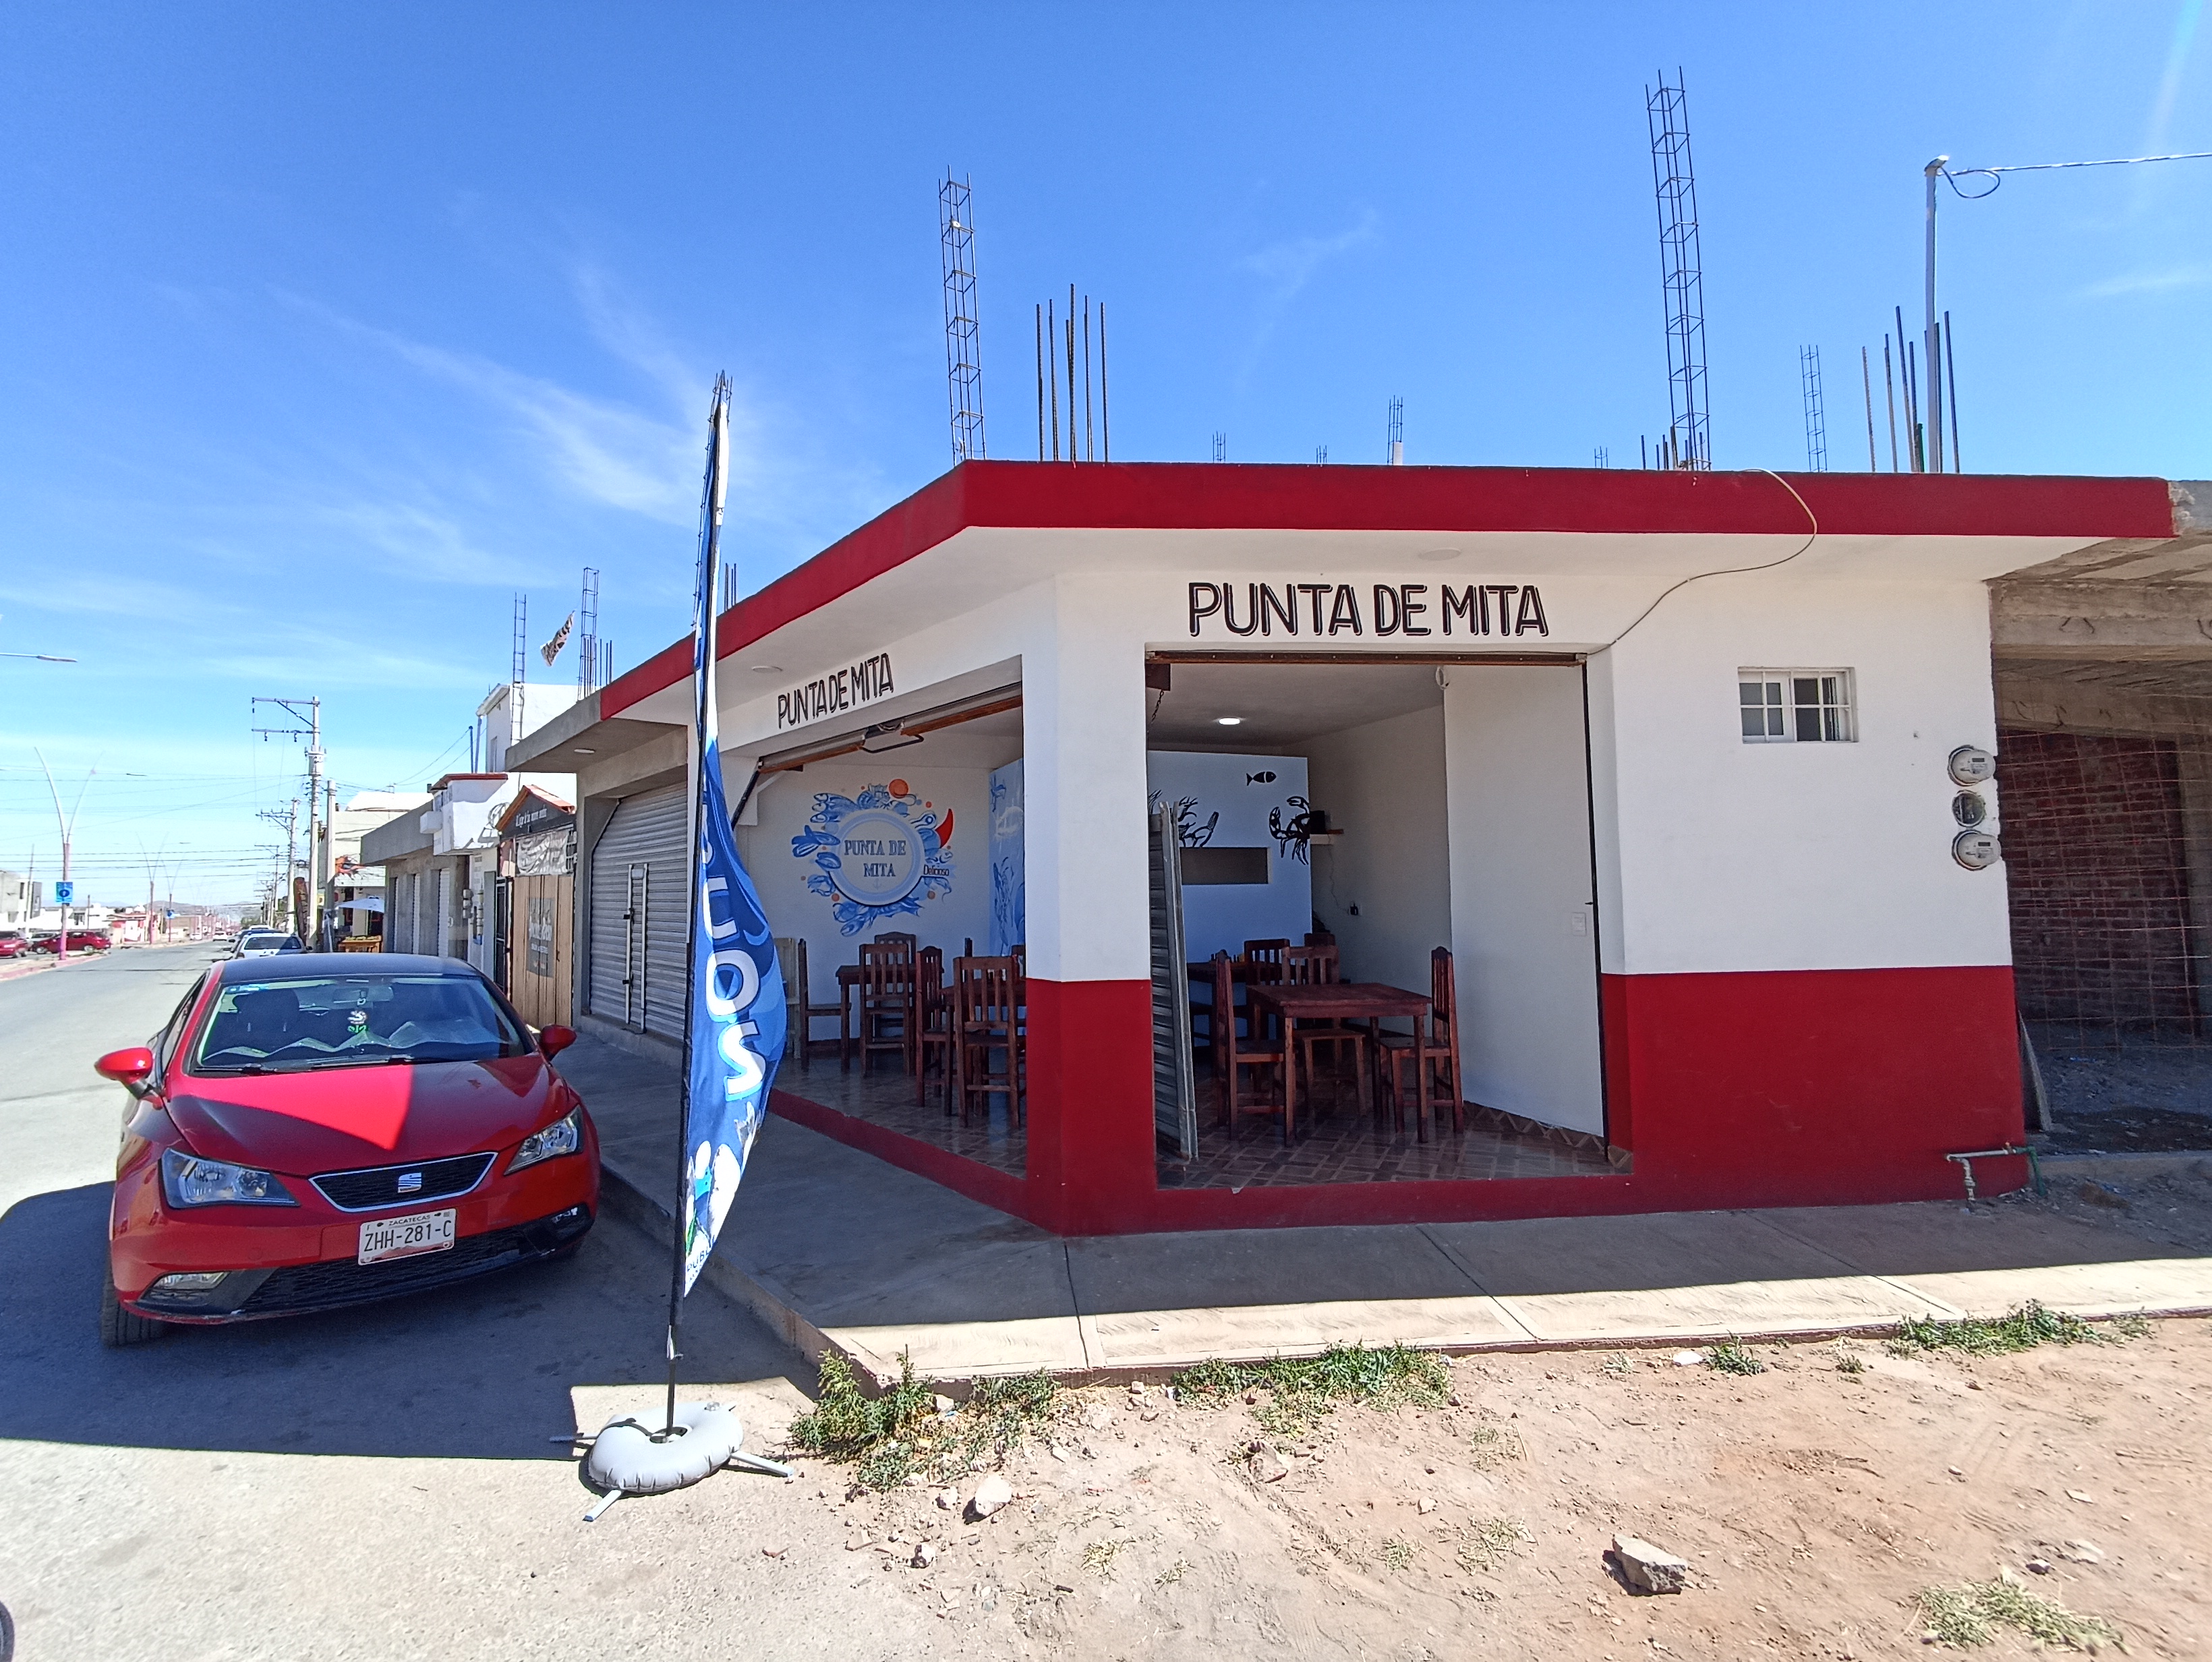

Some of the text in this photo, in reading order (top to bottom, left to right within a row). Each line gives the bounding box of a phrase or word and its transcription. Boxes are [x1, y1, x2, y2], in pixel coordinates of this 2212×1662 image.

[1188, 582, 1549, 637] PUNTA DE MITA
[778, 652, 894, 730] PUNTA DE MITA
[844, 840, 906, 856] PUNTA DE
[863, 863, 896, 877] MITA
[923, 864, 950, 876] Delicioso
[388, 1215, 431, 1226] ZACATECAS
[363, 1220, 452, 1252] ZHH-281-C
